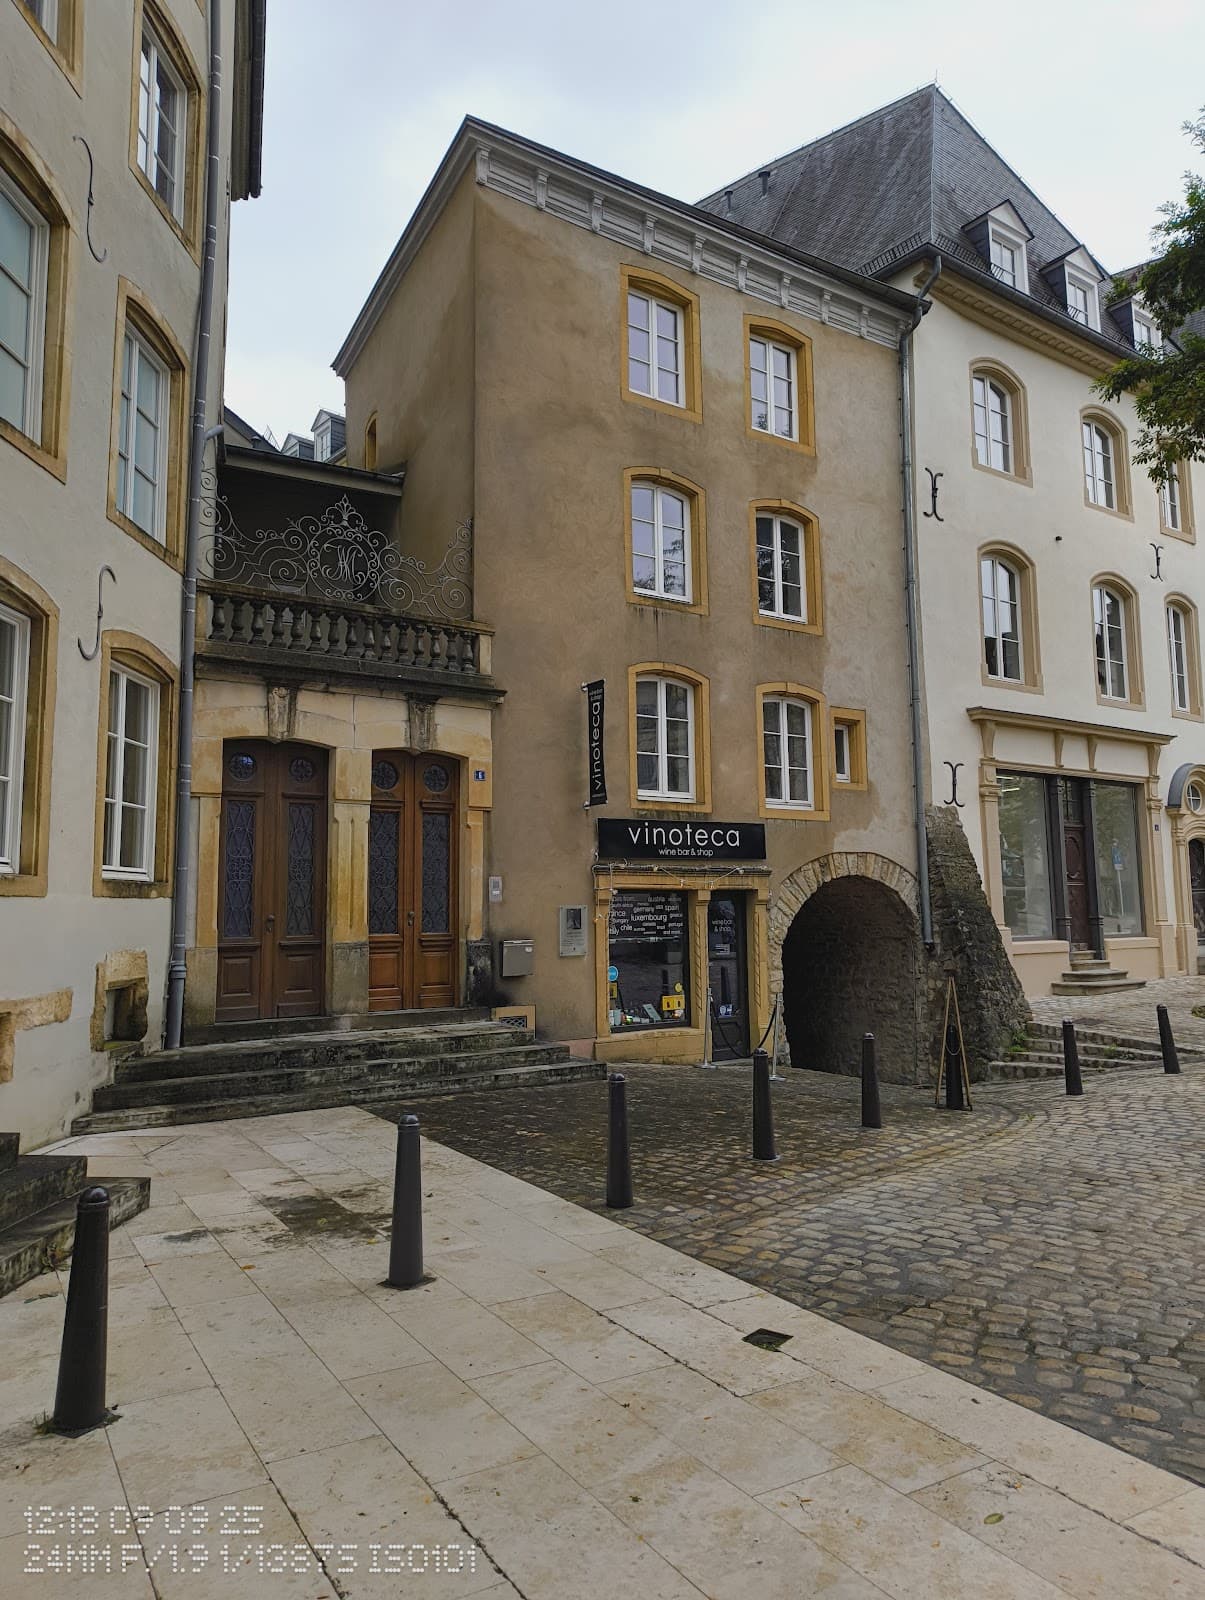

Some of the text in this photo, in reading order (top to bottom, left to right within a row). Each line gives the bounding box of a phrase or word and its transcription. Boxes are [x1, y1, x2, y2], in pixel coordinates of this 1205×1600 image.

[592, 702, 602, 790] vinoteca
[628, 822, 740, 847] vinoteca
[659, 848, 714, 857] wine bar & shop
[631, 914, 668, 922] luxembourg
